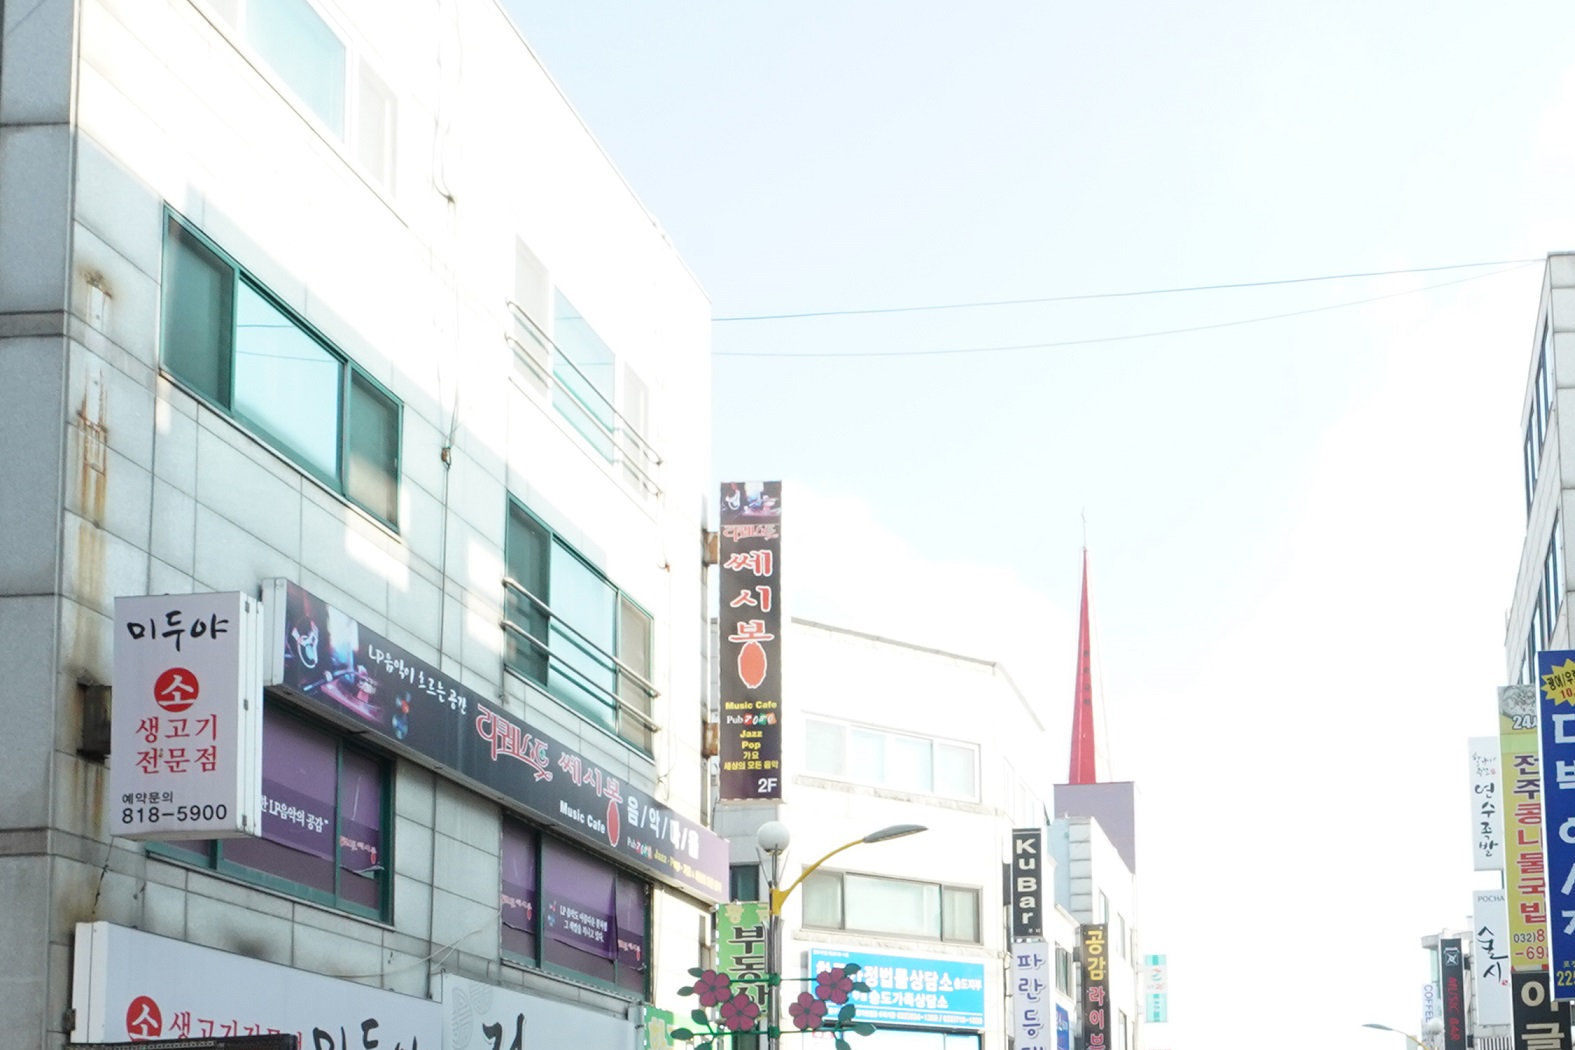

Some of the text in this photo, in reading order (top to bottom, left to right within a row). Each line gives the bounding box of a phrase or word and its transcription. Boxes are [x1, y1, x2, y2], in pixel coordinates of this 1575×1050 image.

[127, 611, 229, 652] 미두야
[158, 674, 196, 707] 소
[725, 701, 777, 710] Music Cafe
[136, 714, 217, 743] 생고기
[739, 730, 763, 738] Jazz
[135, 745, 217, 774] 전문점
[741, 741, 761, 749] Pop
[743, 751, 759, 760] 가요
[122, 791, 173, 805] 예약문의
[757, 778, 777, 793] 2F
[121, 804, 228, 824] 818-5900
[560, 800, 606, 834] Music Cafe
[1016, 838, 1036, 870] Ku
[1017, 877, 1037, 924] Bar
[1085, 930, 1106, 981] 공감
